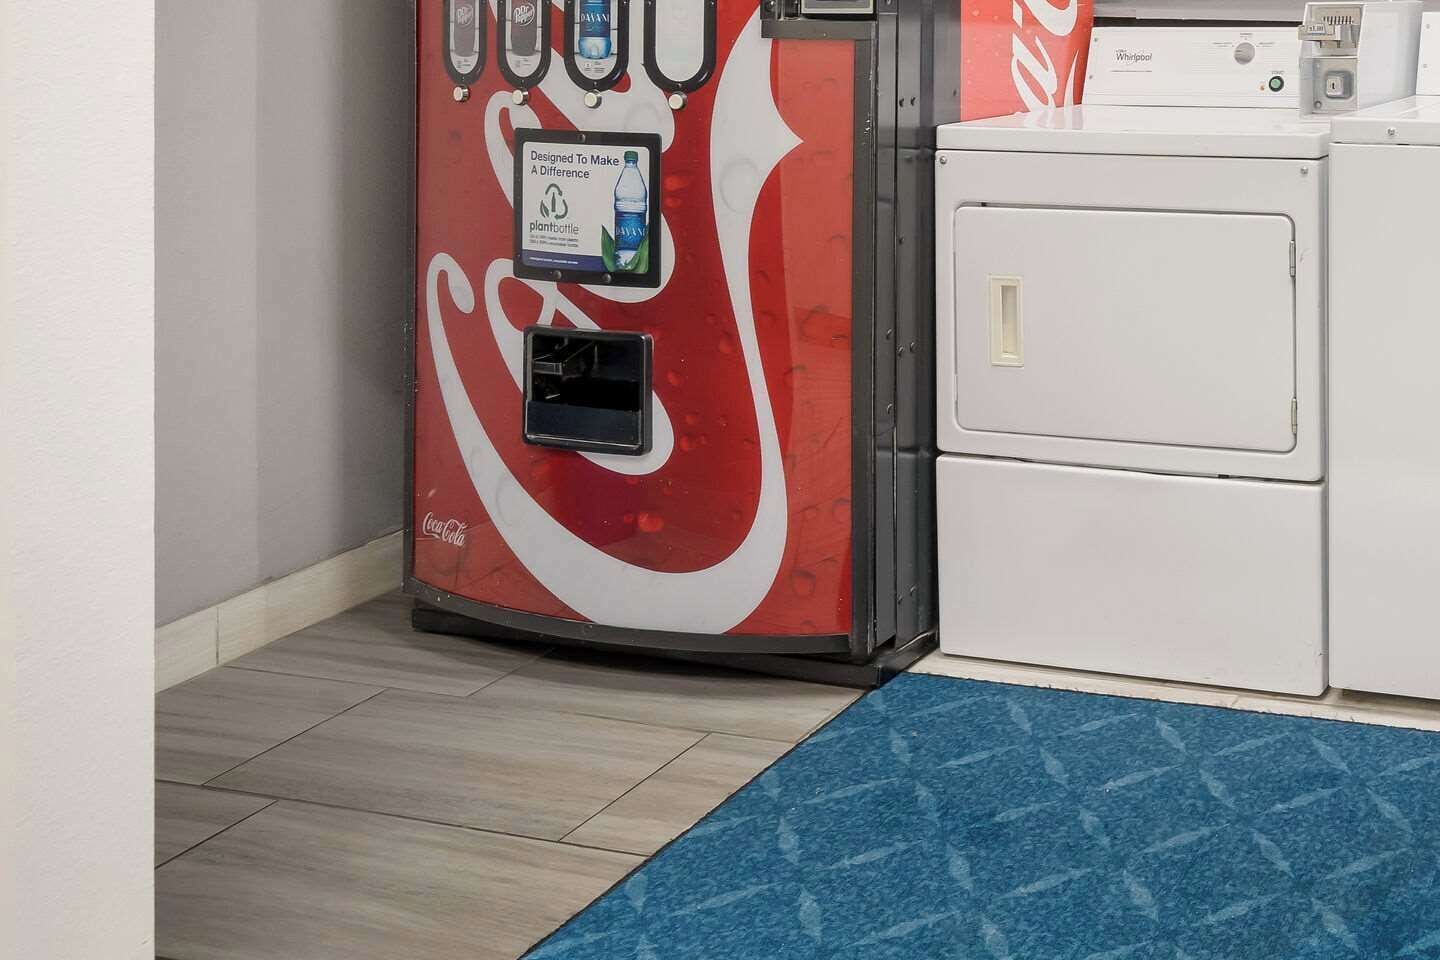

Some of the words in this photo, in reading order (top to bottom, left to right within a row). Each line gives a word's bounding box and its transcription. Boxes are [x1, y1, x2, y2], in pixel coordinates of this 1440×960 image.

[1116, 52, 1153, 63] Whirlpool
[530, 150, 574, 164] Designed
[576, 153, 588, 165] To
[590, 155, 620, 166] Make
[531, 166, 538, 175] A
[540, 166, 590, 179] Difference
[529, 220, 580, 235] plantbottle
